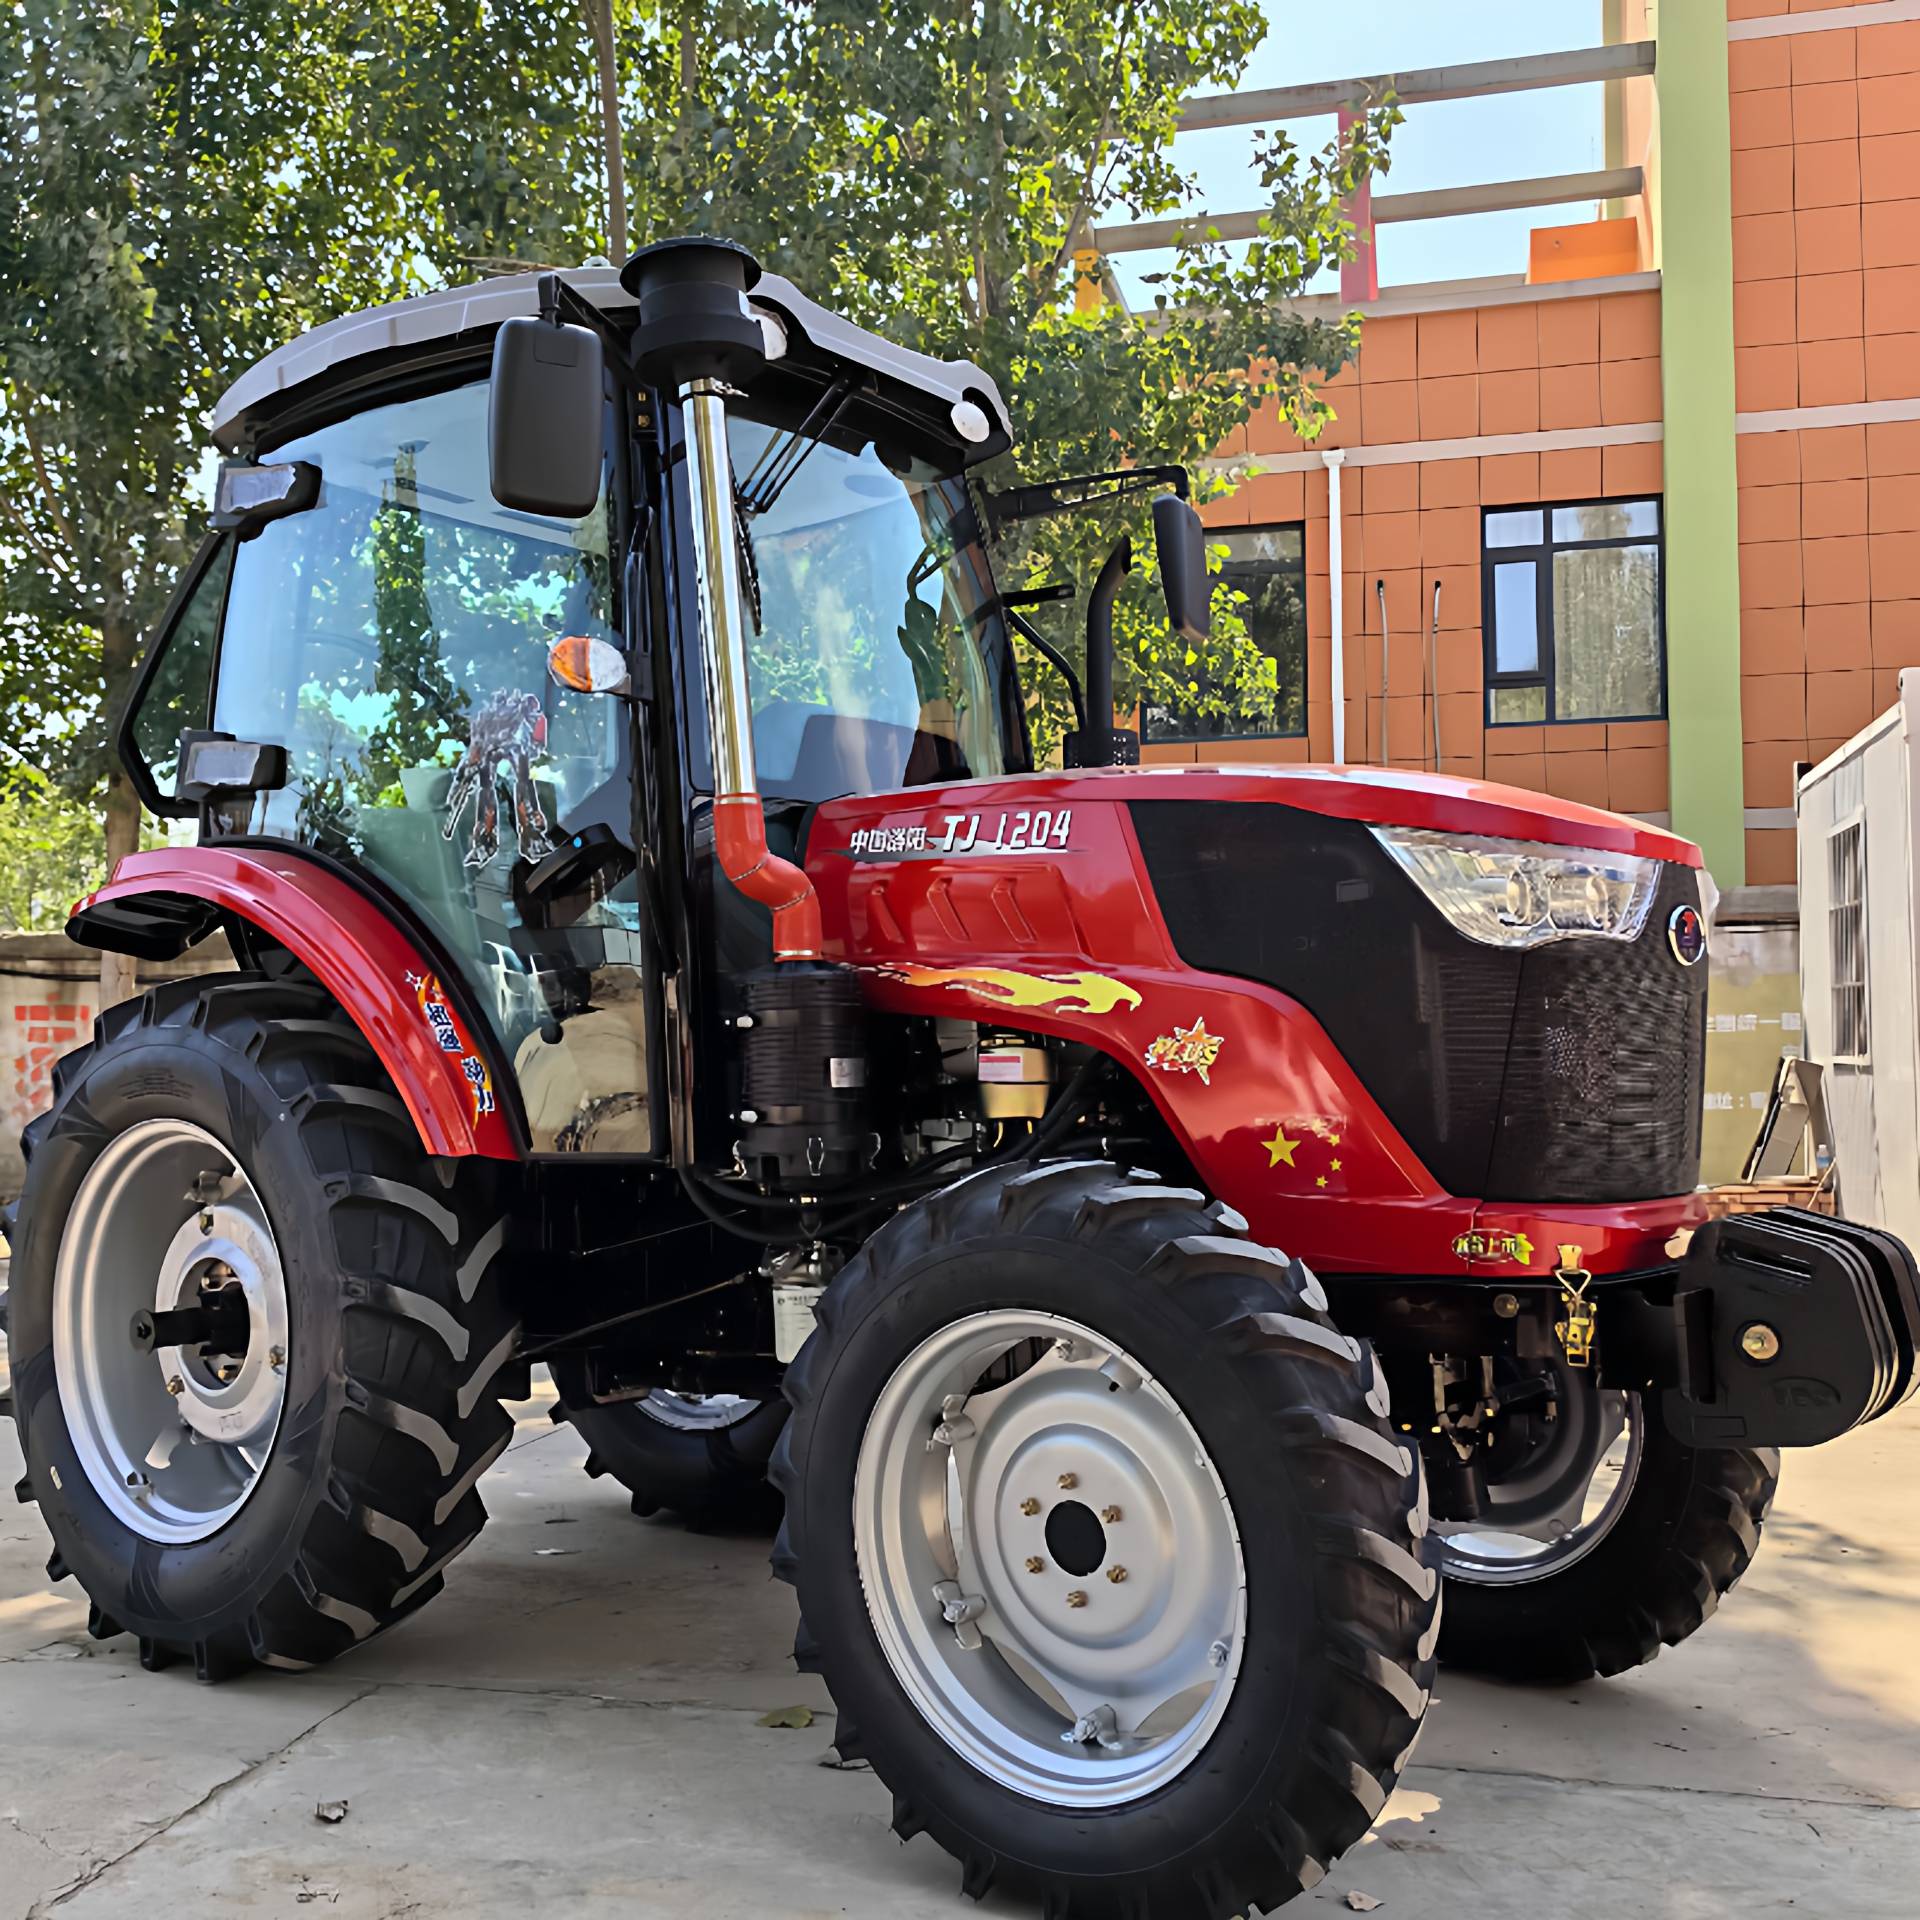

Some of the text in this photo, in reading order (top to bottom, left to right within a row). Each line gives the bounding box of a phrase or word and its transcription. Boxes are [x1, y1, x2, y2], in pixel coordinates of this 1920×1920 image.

[850, 810, 1072, 854] 中国洛阳 TJ 1204
